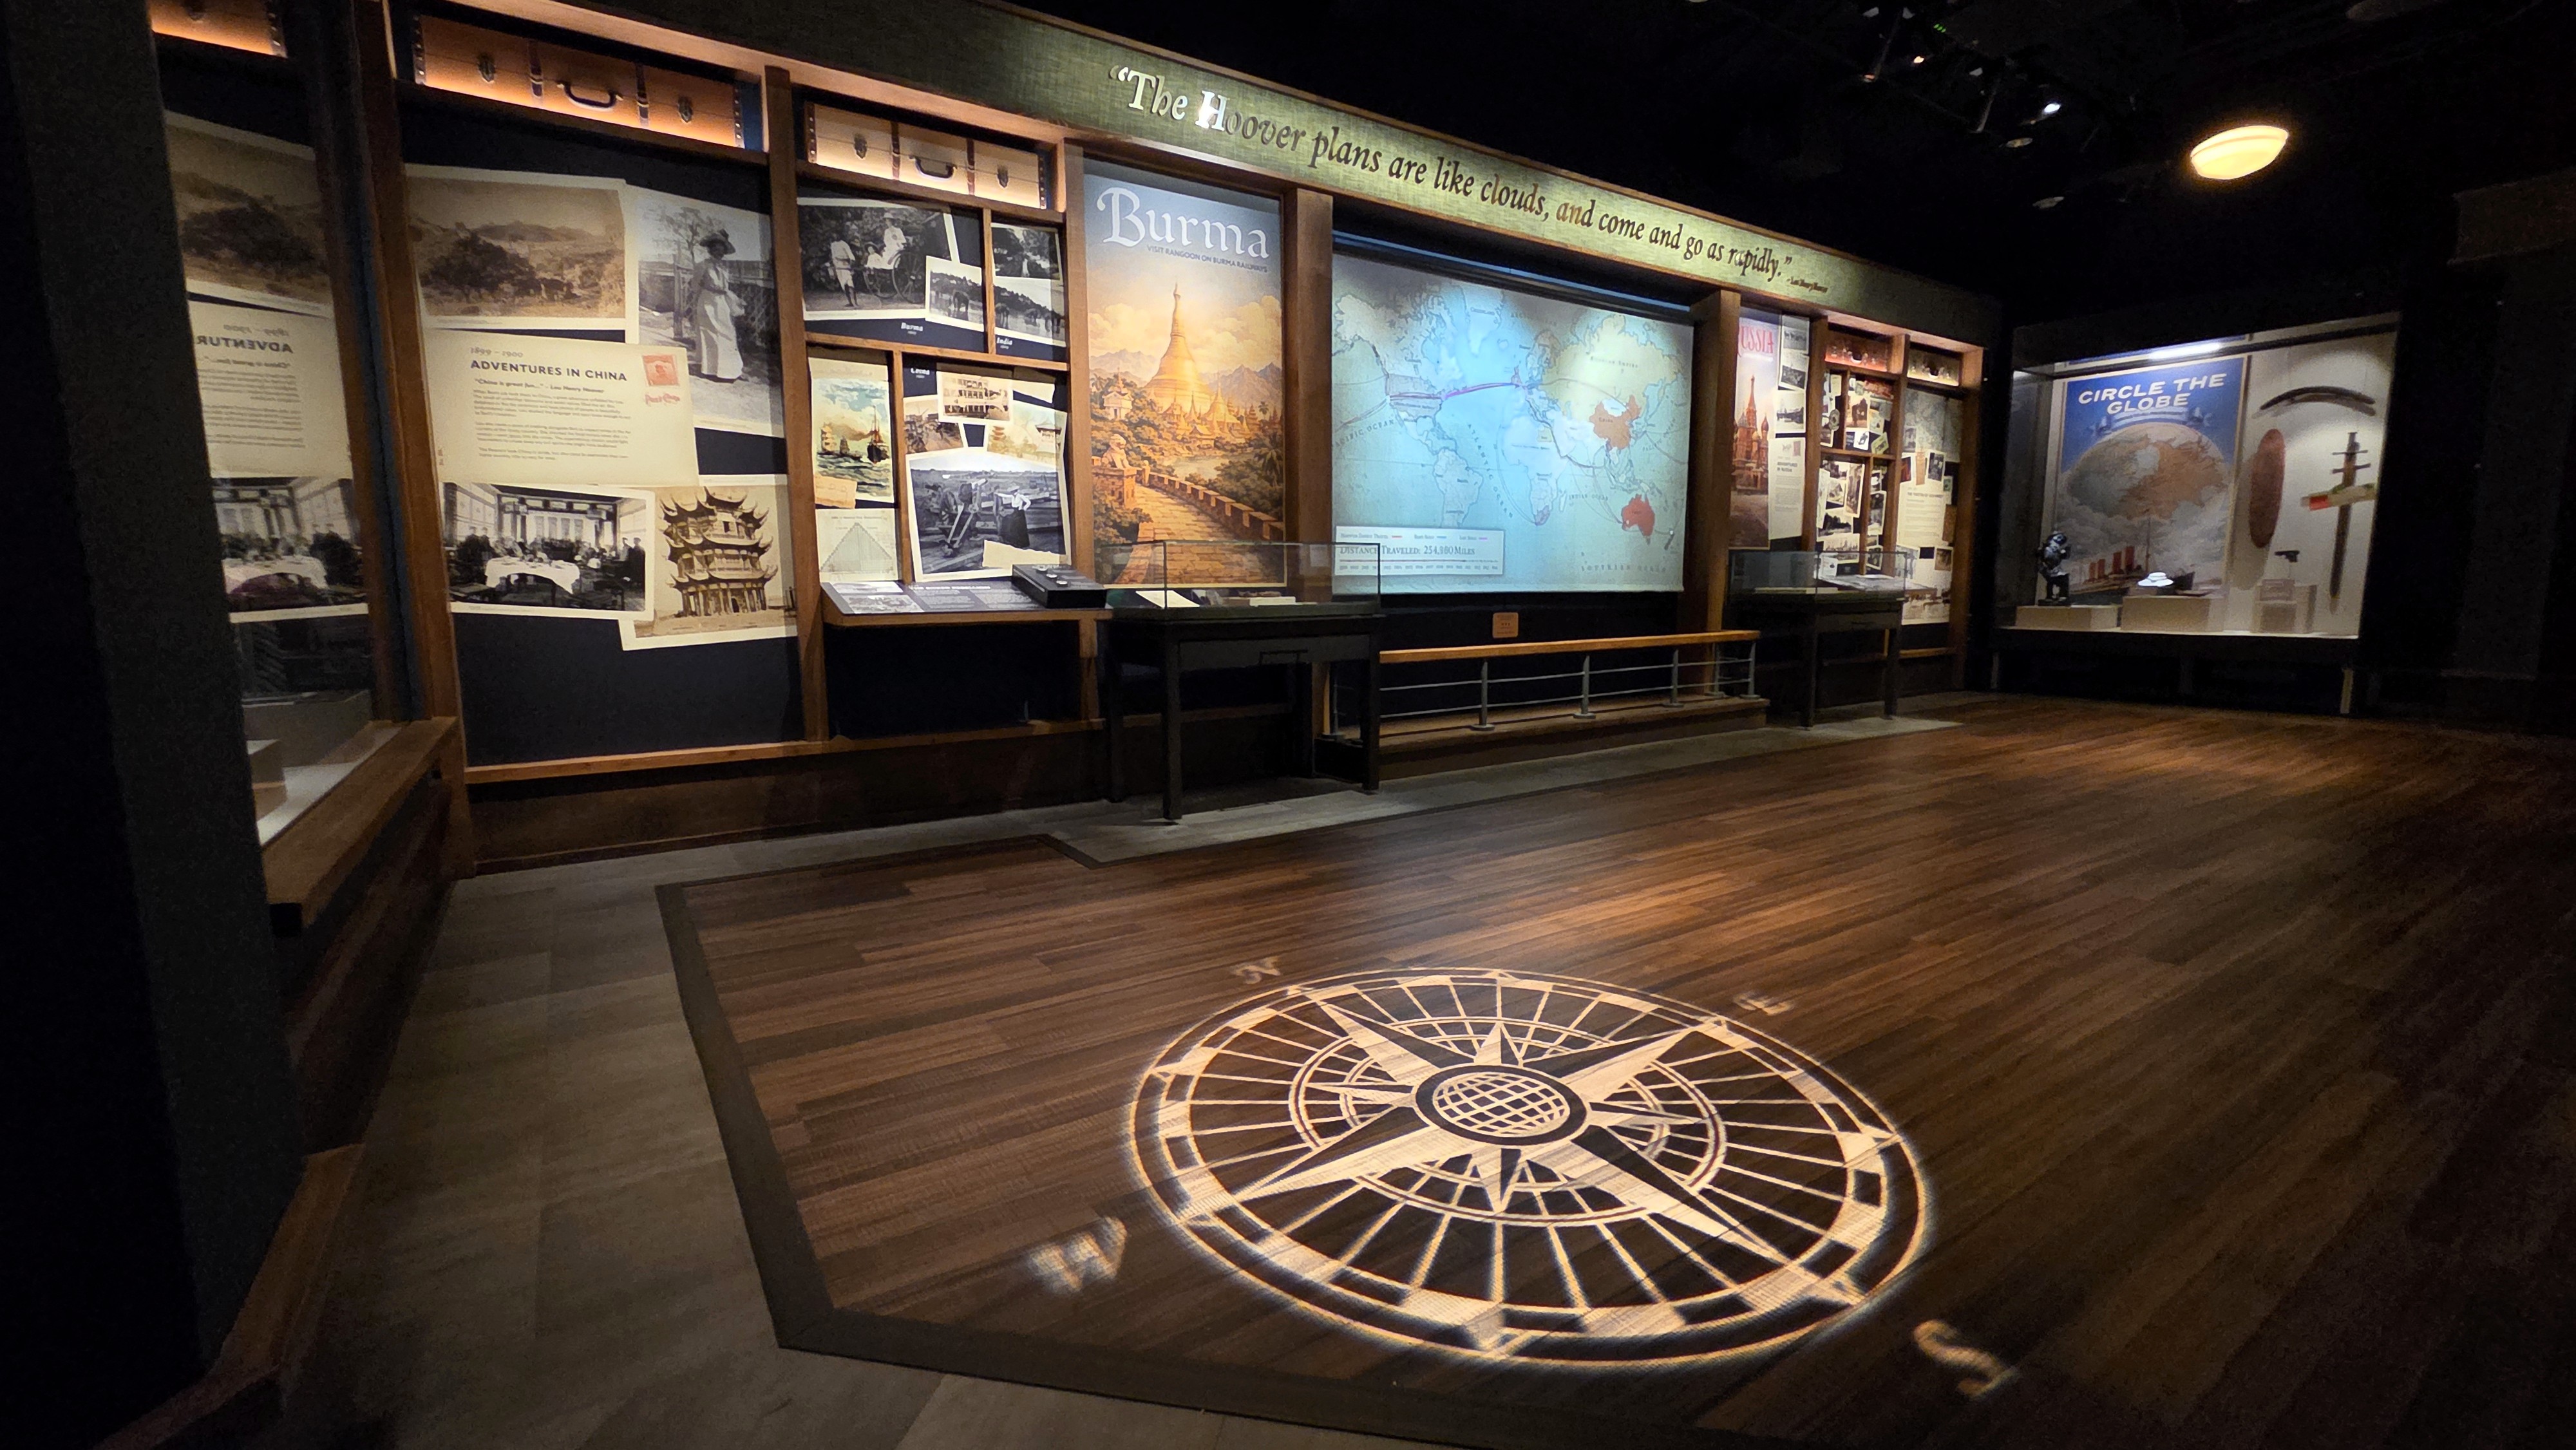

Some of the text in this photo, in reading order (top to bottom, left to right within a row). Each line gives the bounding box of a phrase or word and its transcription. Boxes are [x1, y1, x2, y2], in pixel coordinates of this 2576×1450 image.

[1109, 65, 1792, 282] “The Hoover plans are like clouds, and come and go as rapidly.”
[1097, 187, 1270, 259] Burma
[1147, 245, 1164, 254] VISIT
[1166, 248, 1200, 261] RANGOON
[1213, 256, 1236, 267] BURMA
[1237, 261, 1268, 272] RAILWAYS
[1739, 325, 1774, 354] USSIA
[470, 360, 627, 382] ADVENTURES IN CHINA
[2078, 373, 2227, 404] CIRCLE THE
[2107, 392, 2191, 415] GLOBE
[1913, 1320, 2019, 1400] S
